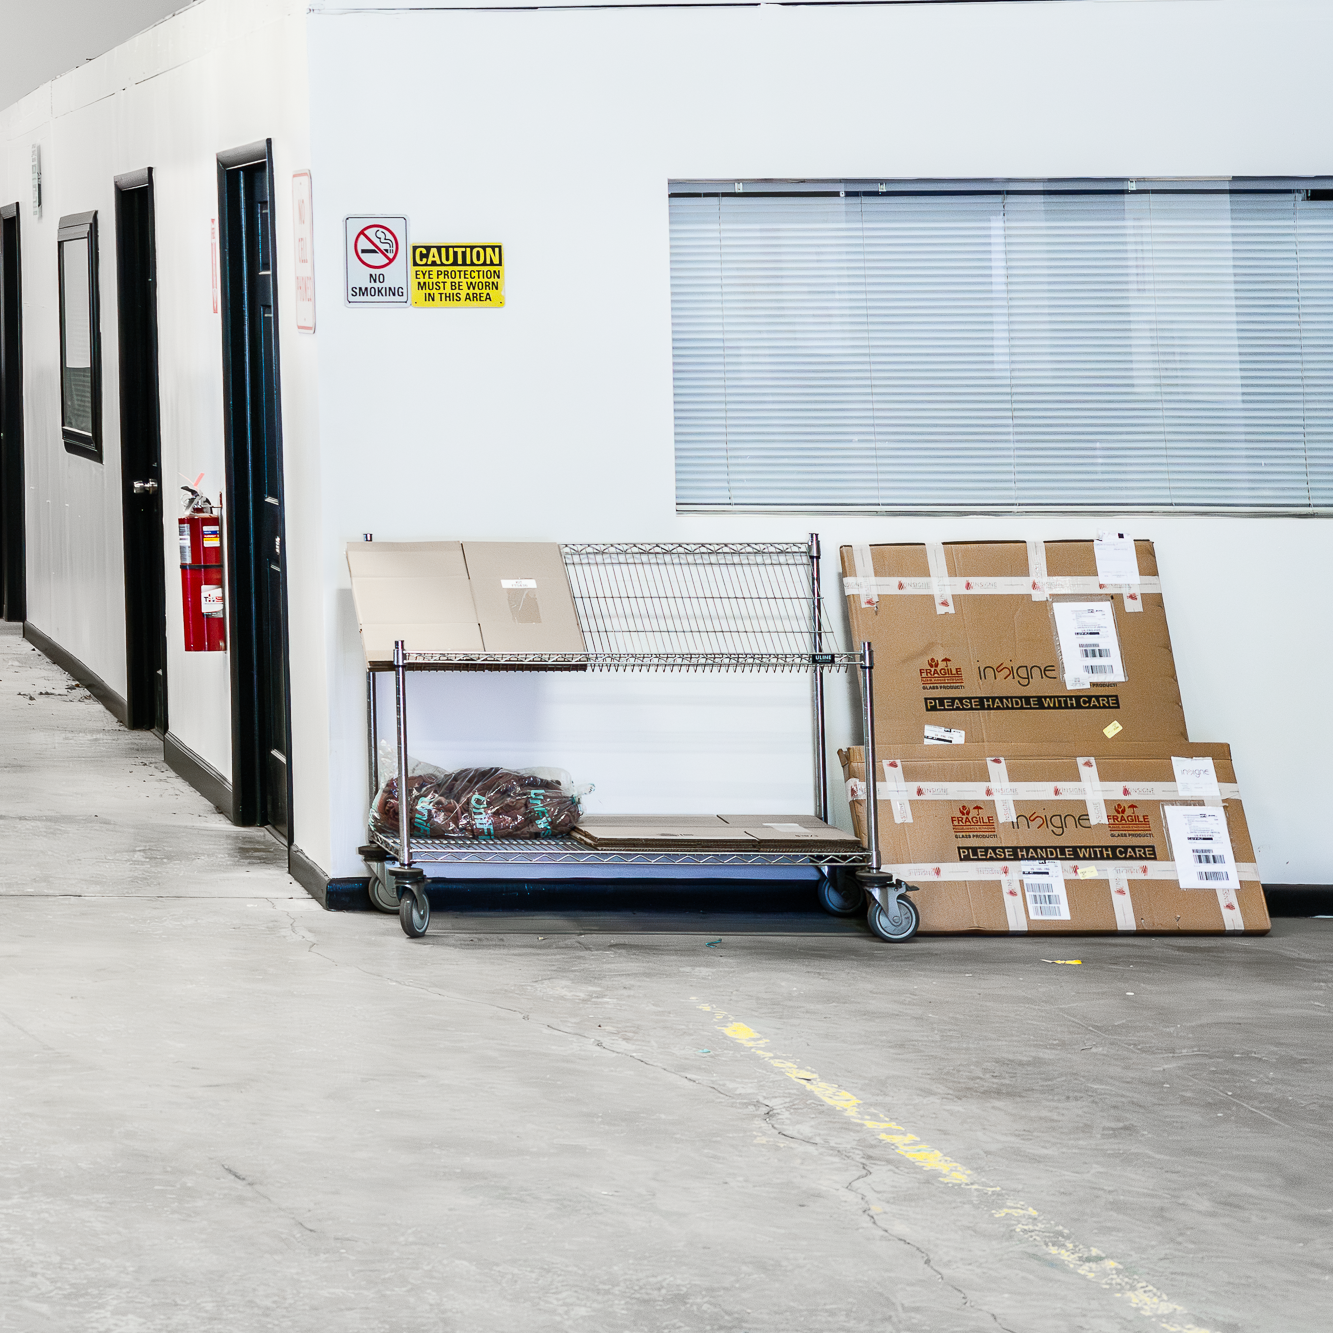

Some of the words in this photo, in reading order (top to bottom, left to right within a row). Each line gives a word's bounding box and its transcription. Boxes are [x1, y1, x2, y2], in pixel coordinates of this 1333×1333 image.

[414, 247, 500, 265] CAUTION
[369, 273, 385, 284] NO
[415, 270, 433, 279] EYE
[436, 269, 501, 279] PROTECTION
[417, 281, 447, 291] MUST
[450, 281, 464, 290] BE
[466, 281, 499, 290] WORN
[351, 286, 404, 297] SMOKING
[424, 292, 435, 302] IN
[438, 292, 462, 302] THIS
[464, 292, 492, 302] AREA
[919, 667, 963, 677] FRAGILE
[976, 659, 1057, 687] insigne
[927, 699, 980, 709] PLEASE
[984, 698, 1039, 709] HANDLE
[1042, 697, 1076, 708] WITH
[1080, 696, 1118, 707] CARE
[951, 816, 994, 824] FRAGILE
[1107, 814, 1149, 823] FRAGILE
[960, 848, 1014, 859] PLEASE
[1018, 847, 1075, 859] HANDLE
[1077, 847, 1113, 858] WITH
[1116, 846, 1155, 858] CARE
